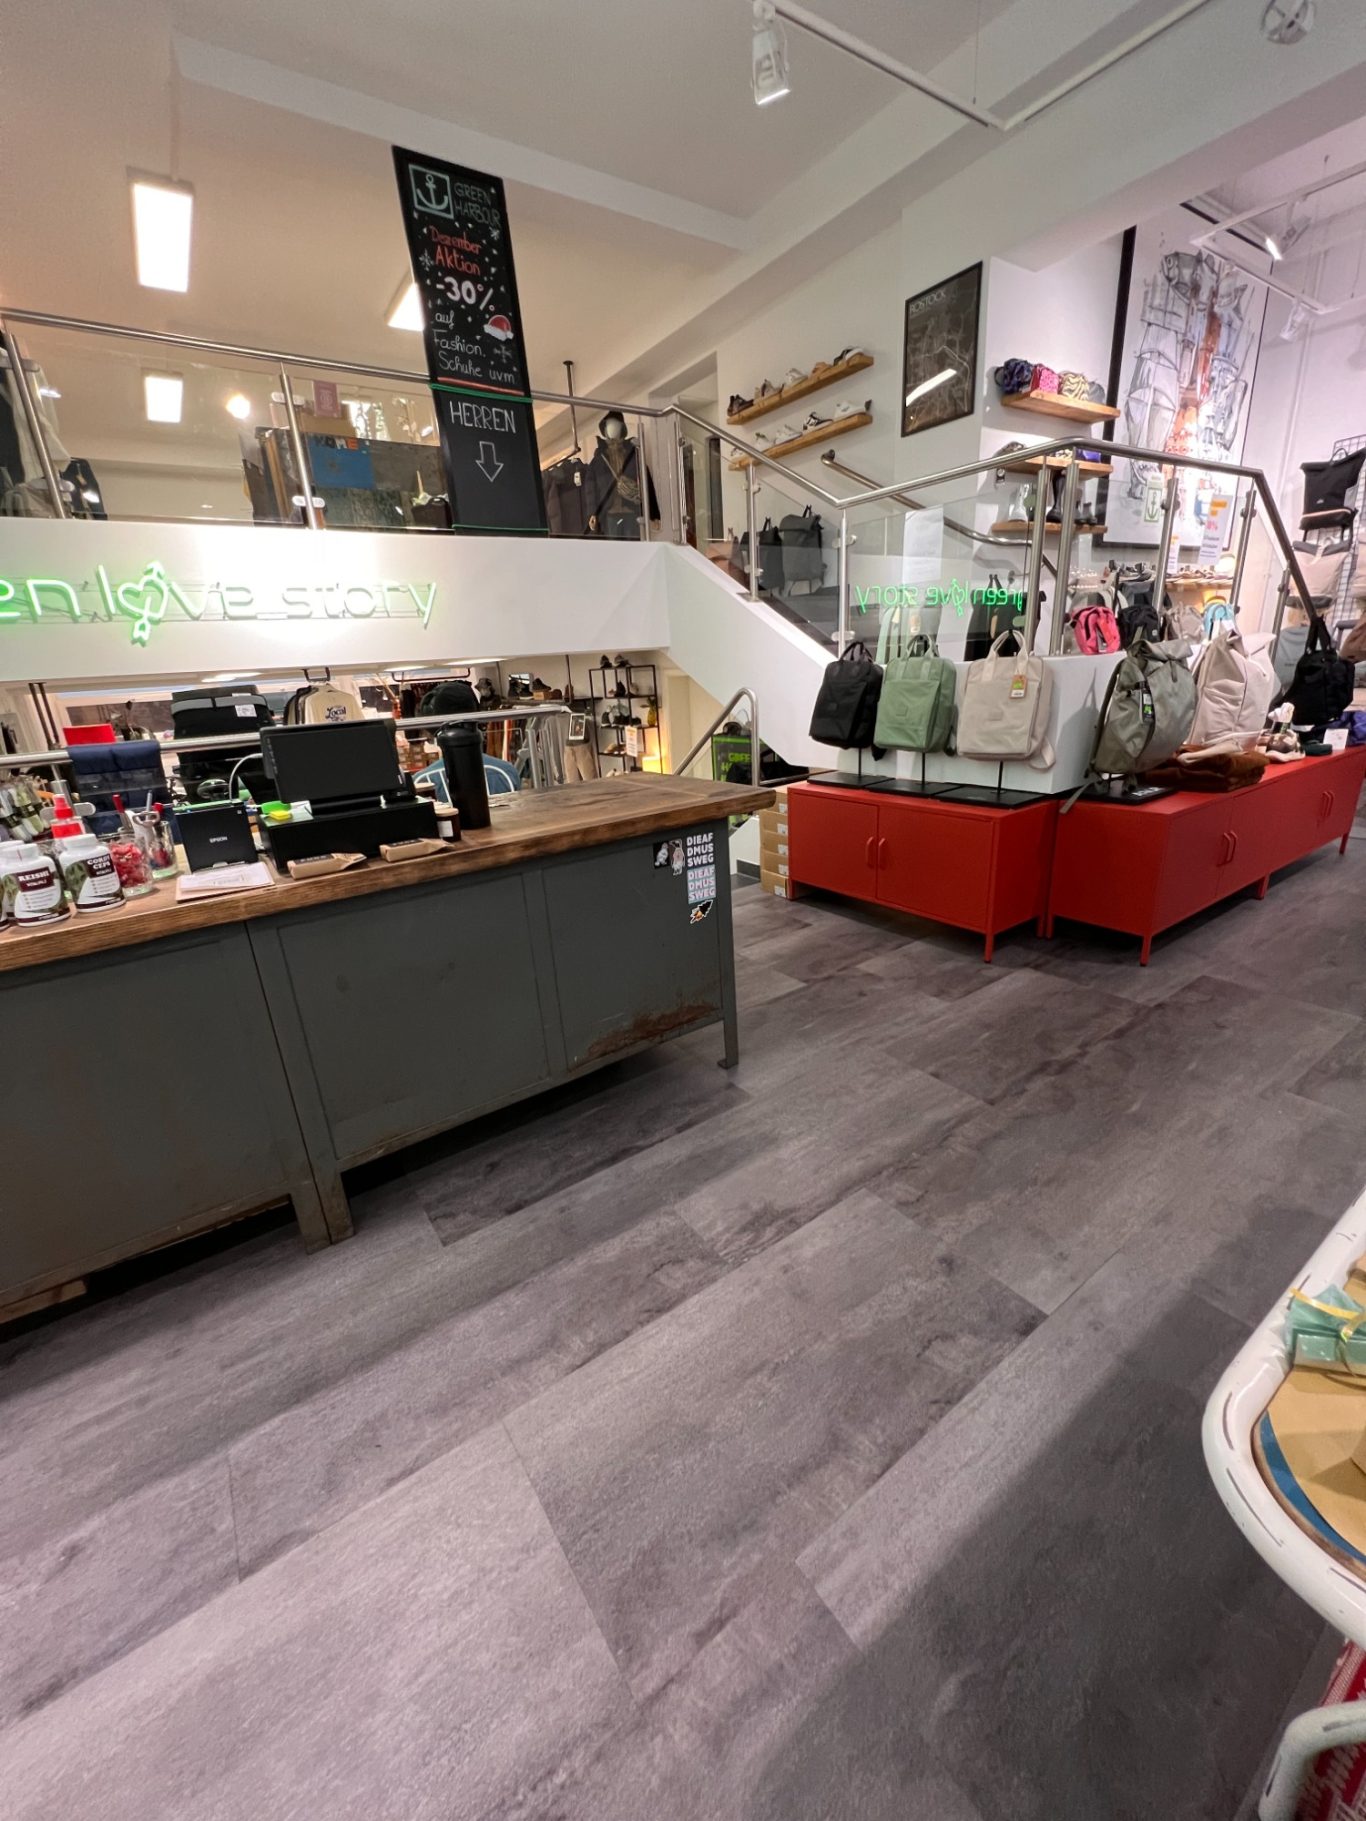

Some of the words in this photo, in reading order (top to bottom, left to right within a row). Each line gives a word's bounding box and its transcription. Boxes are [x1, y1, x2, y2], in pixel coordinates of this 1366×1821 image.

[454, 182, 492, 205] GREEN
[453, 198, 501, 228] HARBOUR
[429, 225, 482, 254] Dezember
[435, 244, 480, 275] Aktion
[436, 276, 495, 311] -30%
[909, 288, 945, 314] ROSTOCK
[435, 310, 455, 330] auf
[438, 350, 483, 377] Schuhe
[449, 400, 516, 434] HERREN
[281, 582, 437, 630] story
[209, 836, 228, 844] EPSON
[687, 833, 714, 846] DIEAF
[687, 843, 714, 857] DMUS
[687, 853, 714, 867] SWEG
[18, 870, 50, 881] REISHI
[688, 866, 715, 880] DIEAF
[688, 876, 715, 890] DMUS
[688, 887, 716, 901] SWEG
